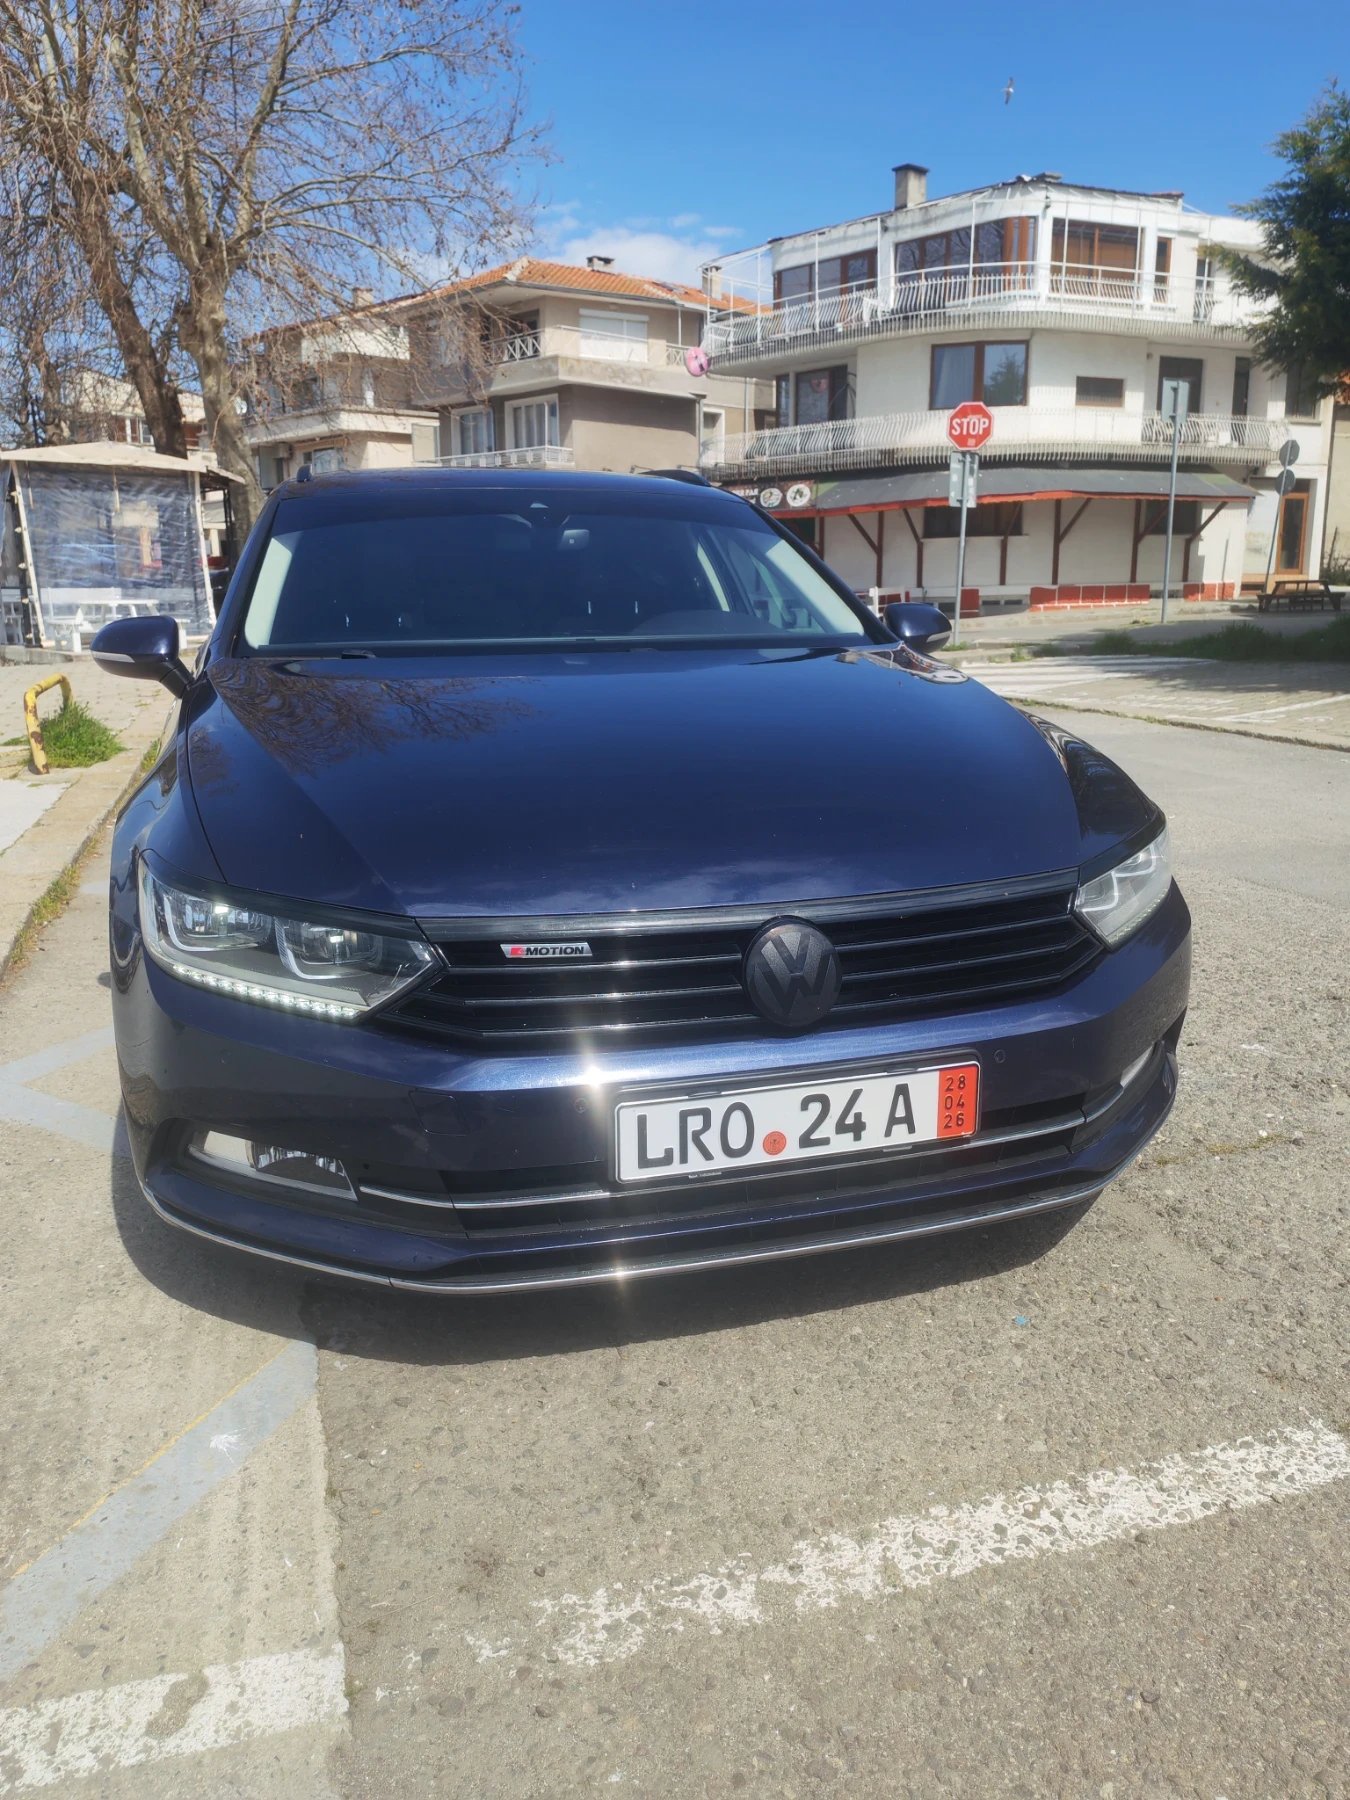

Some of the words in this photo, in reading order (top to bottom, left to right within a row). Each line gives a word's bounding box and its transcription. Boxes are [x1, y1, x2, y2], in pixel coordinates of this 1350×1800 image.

[951, 417, 989, 436] STOP
[945, 1074, 966, 1092] 28
[944, 1093, 966, 1110] 04
[636, 1101, 755, 1169] LRO
[798, 1088, 867, 1149] 24
[884, 1083, 916, 1138] A
[943, 1111, 965, 1129] 26
